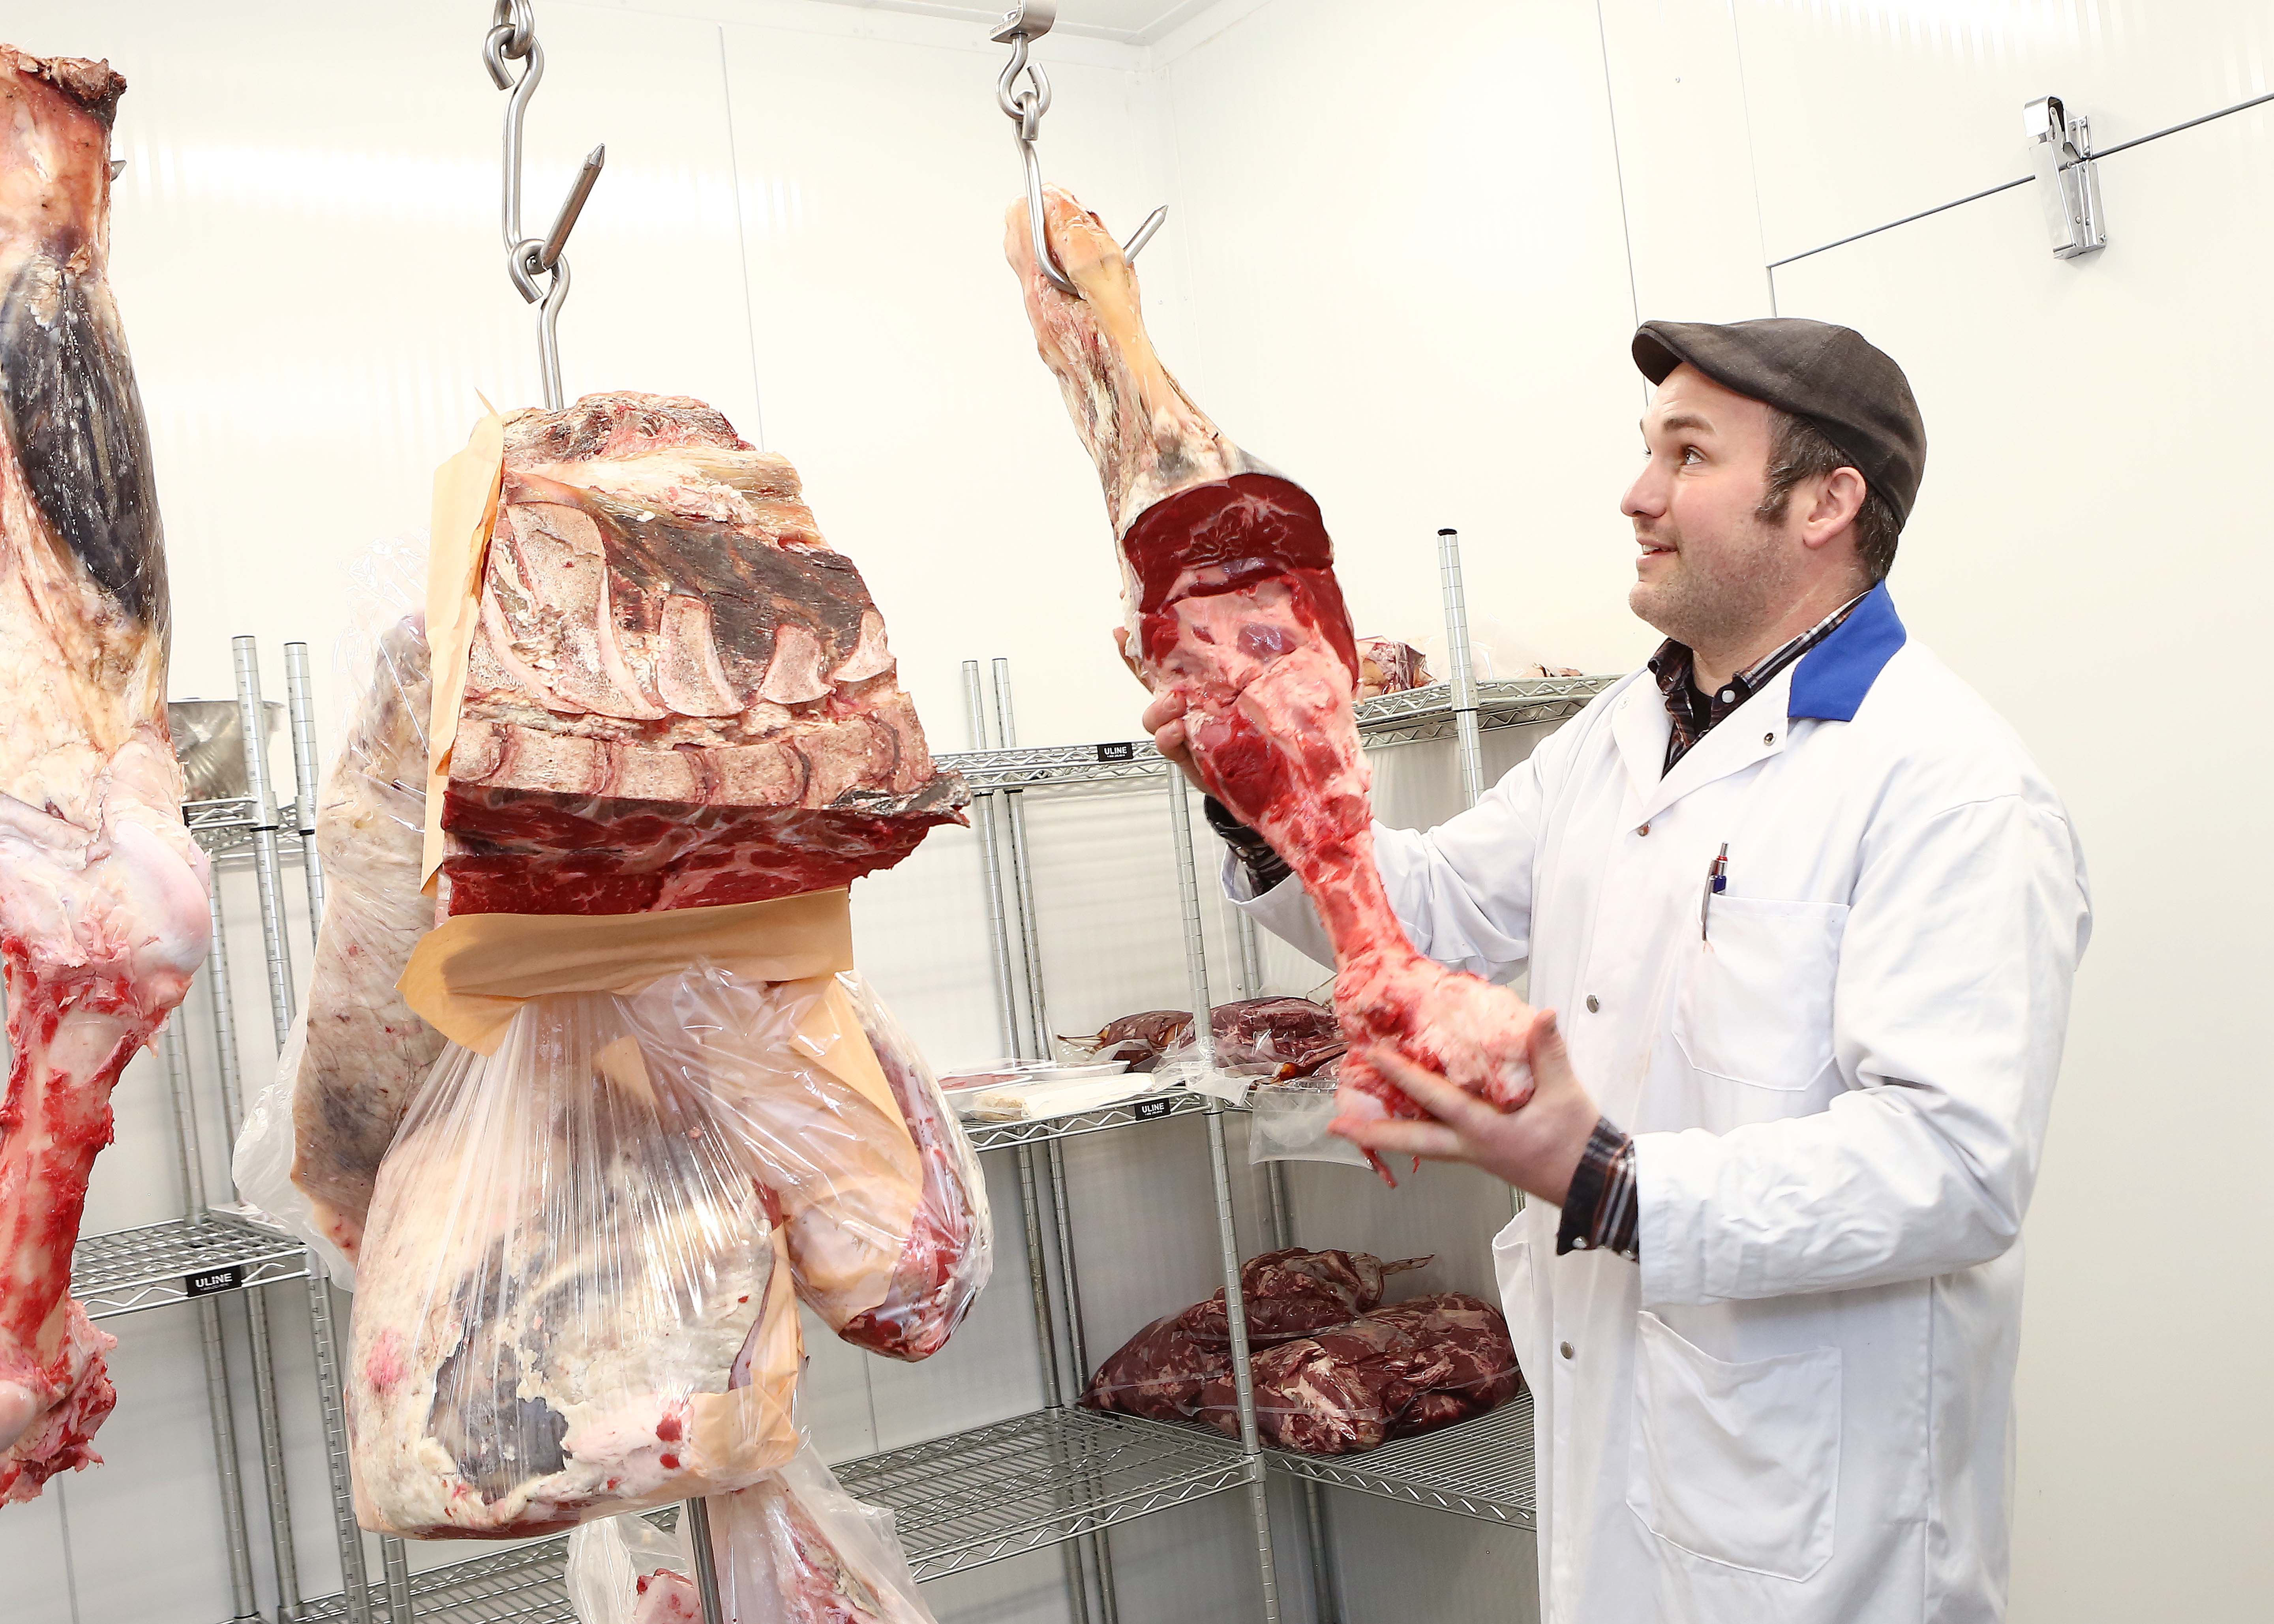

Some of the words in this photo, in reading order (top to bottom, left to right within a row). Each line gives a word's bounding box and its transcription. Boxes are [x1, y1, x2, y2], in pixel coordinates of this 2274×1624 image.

[1104, 746, 1127, 755] ULINE
[1142, 1103, 1164, 1113] ULINE
[195, 1273, 233, 1287] ULINE
